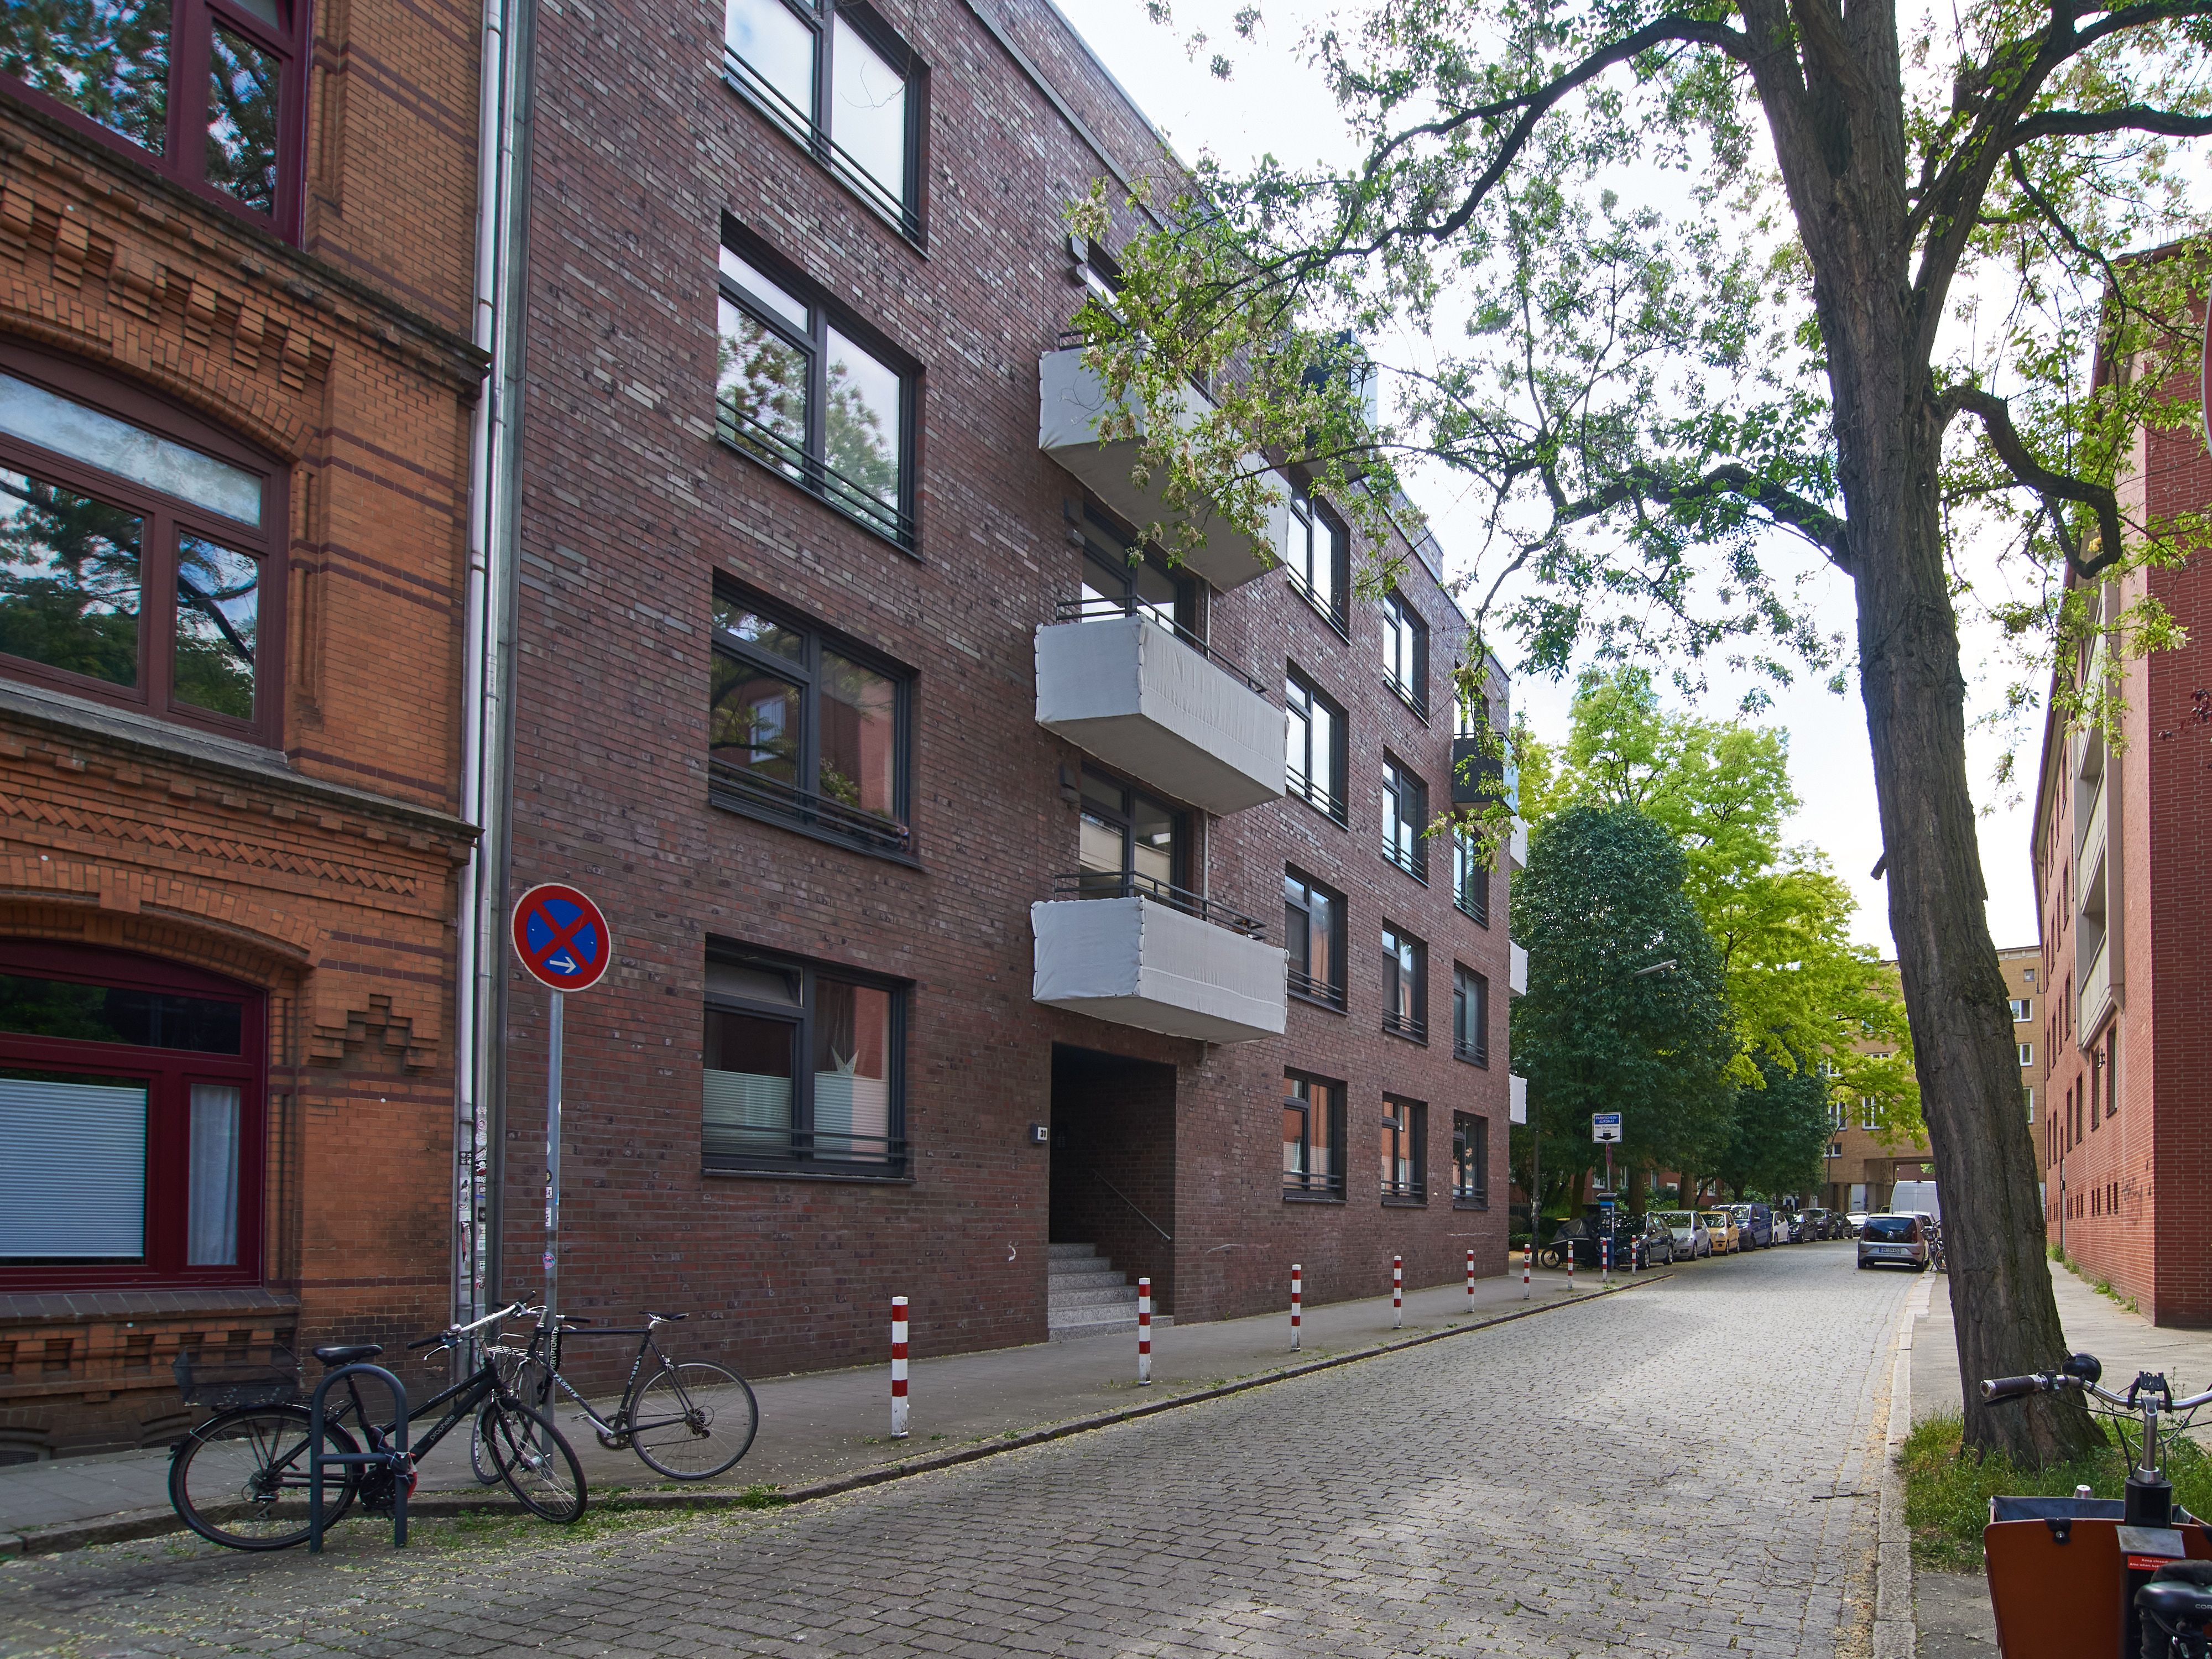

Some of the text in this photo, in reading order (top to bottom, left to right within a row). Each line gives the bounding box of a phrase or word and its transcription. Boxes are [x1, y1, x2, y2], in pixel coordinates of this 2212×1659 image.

[550, 1326, 559, 1369] KRYPTONITE
[628, 1355, 642, 1385] FAGGIN
[553, 1373, 581, 1399] FAGGIN
[429, 1415, 455, 1441] prophete
